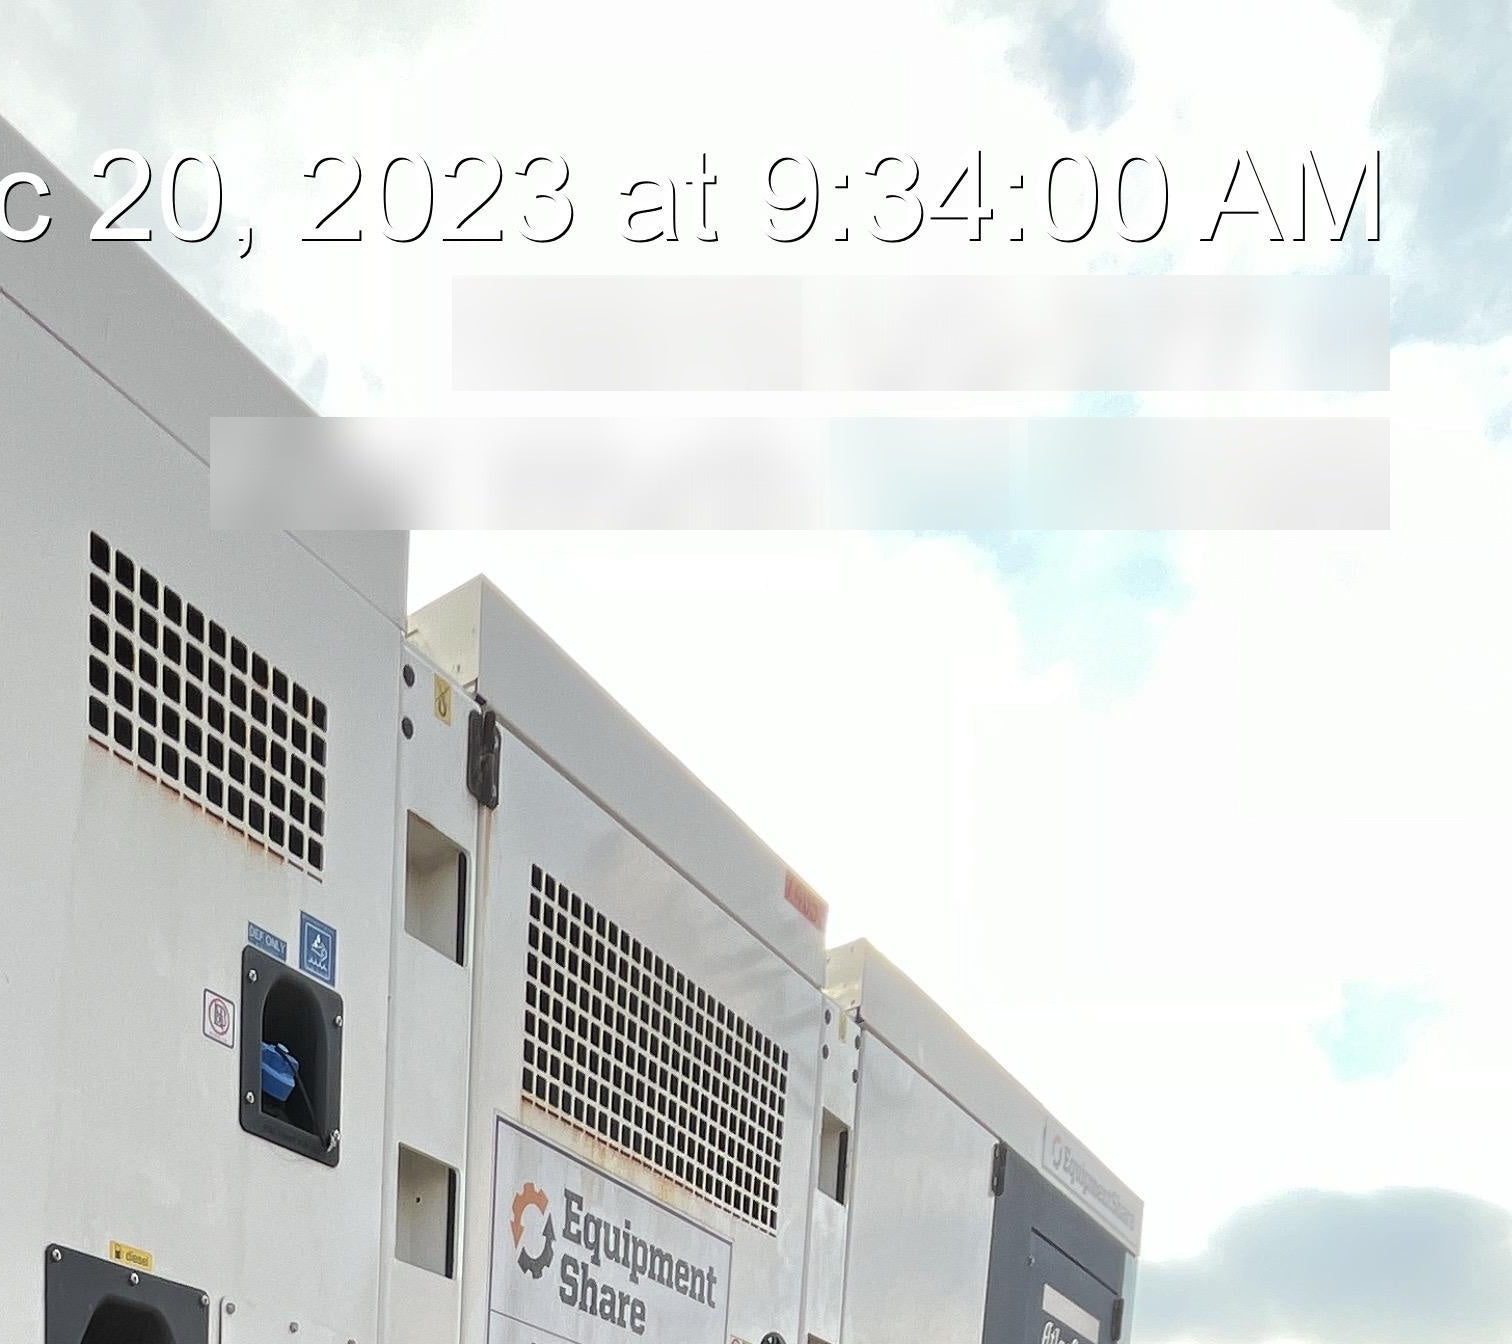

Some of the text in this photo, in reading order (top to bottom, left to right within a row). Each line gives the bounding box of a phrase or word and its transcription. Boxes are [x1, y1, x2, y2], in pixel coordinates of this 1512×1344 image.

[249, 925, 286, 953] DEF ONLY
[562, 1188, 717, 1308] Equipment
[559, 1254, 646, 1336] Share
